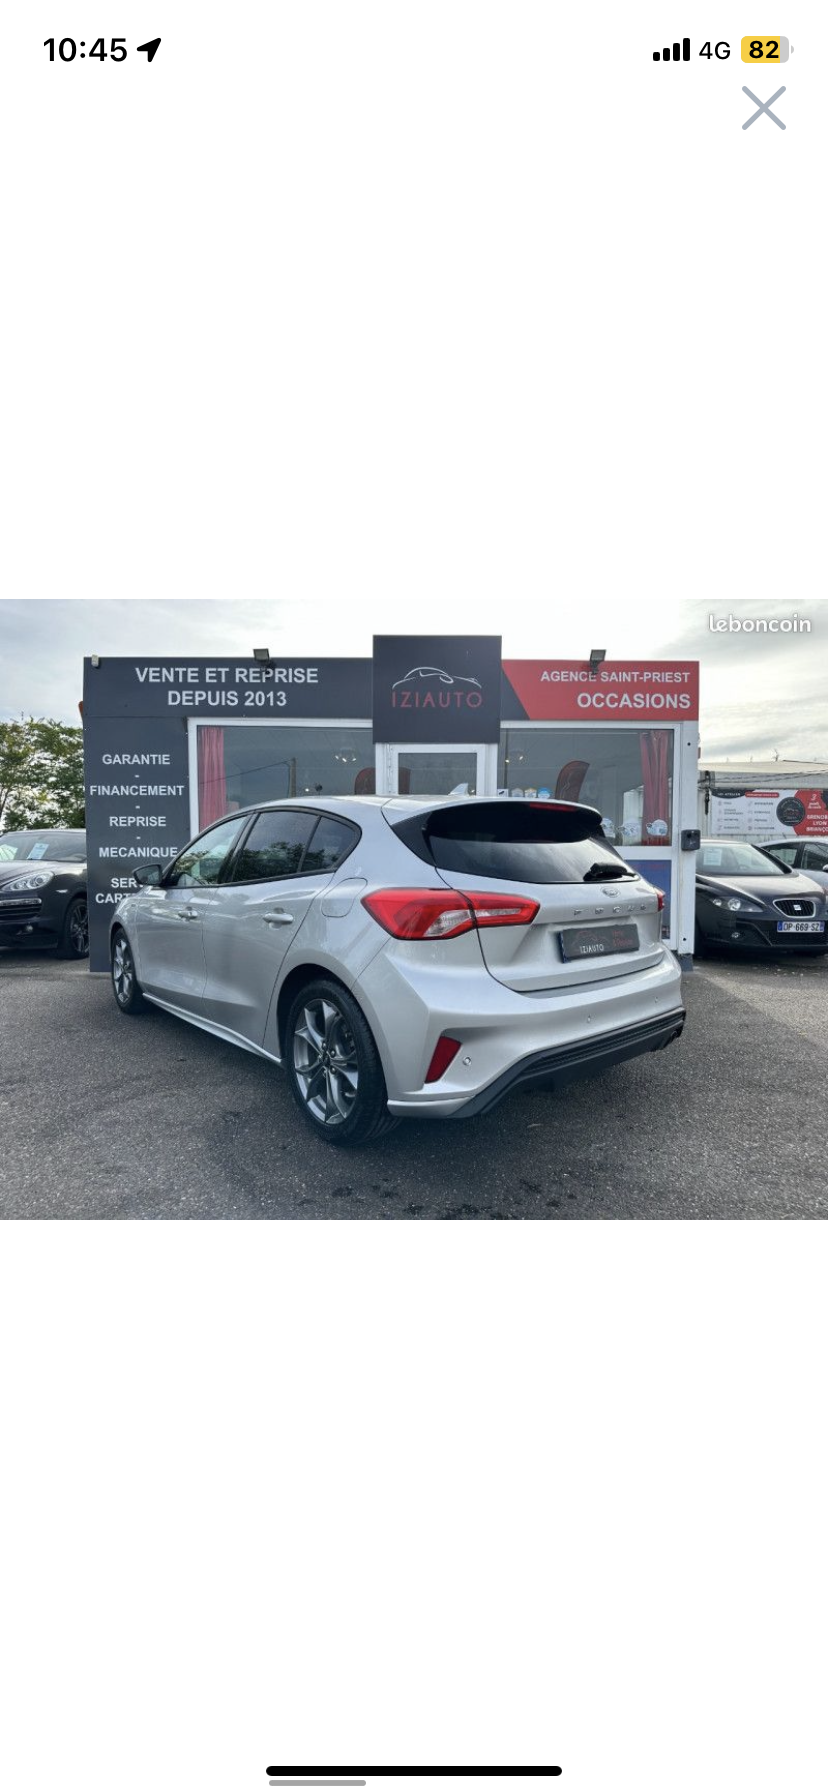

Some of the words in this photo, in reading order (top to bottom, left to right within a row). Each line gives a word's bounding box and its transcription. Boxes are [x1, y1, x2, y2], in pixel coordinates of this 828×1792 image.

[43, 37, 128, 63] 10:45
[698, 41, 731, 60] 4G
[748, 40, 780, 60] 82
[135, 667, 198, 684] VENTE
[205, 667, 229, 684] ET
[235, 667, 319, 684] REPRISE
[540, 670, 597, 683] AGENCE
[600, 670, 690, 683] SAINT-PRIEST
[167, 690, 238, 706] DEPUIS
[244, 690, 287, 707] 2013
[391, 691, 482, 709] IZIAUTO
[577, 692, 691, 710] OCCASIONS
[101, 753, 171, 765] GARANTIE
[89, 785, 185, 796] FINANCEMENT
[109, 816, 167, 828] REPRISE
[98, 846, 178, 859] MECANIQUE
[579, 943, 605, 954] IZIAUTO
